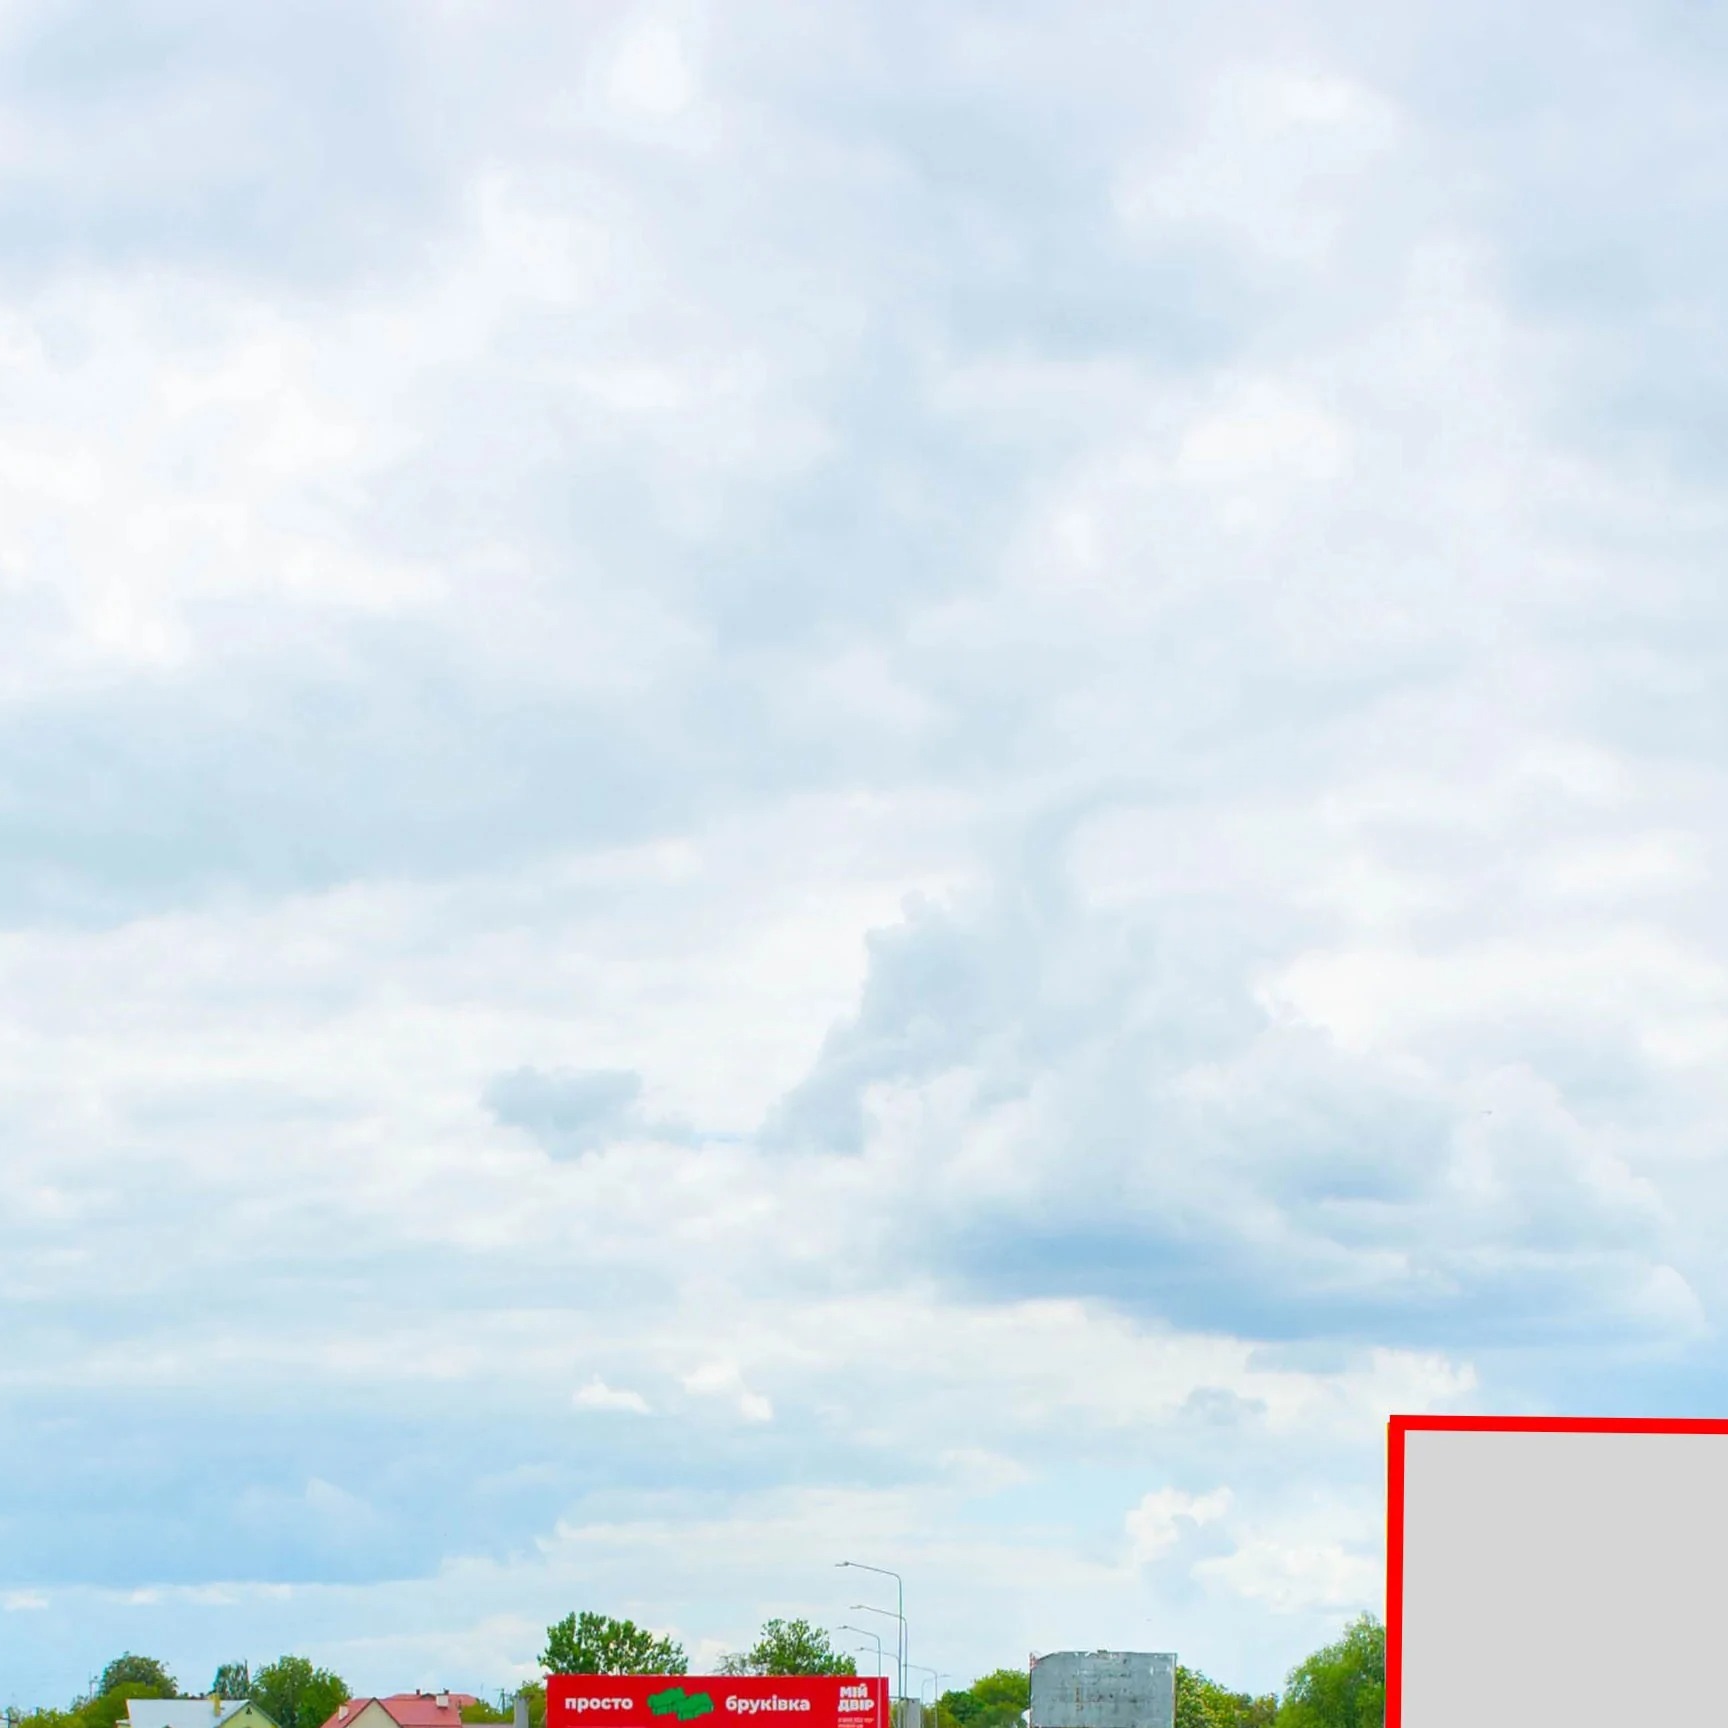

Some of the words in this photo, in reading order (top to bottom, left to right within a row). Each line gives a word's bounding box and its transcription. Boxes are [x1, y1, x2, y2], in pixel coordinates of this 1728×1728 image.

[840, 1683, 868, 1698] МІЙ
[565, 1696, 633, 1713] просто
[725, 1694, 811, 1714] бруківка
[838, 1699, 875, 1712] ДВІР
